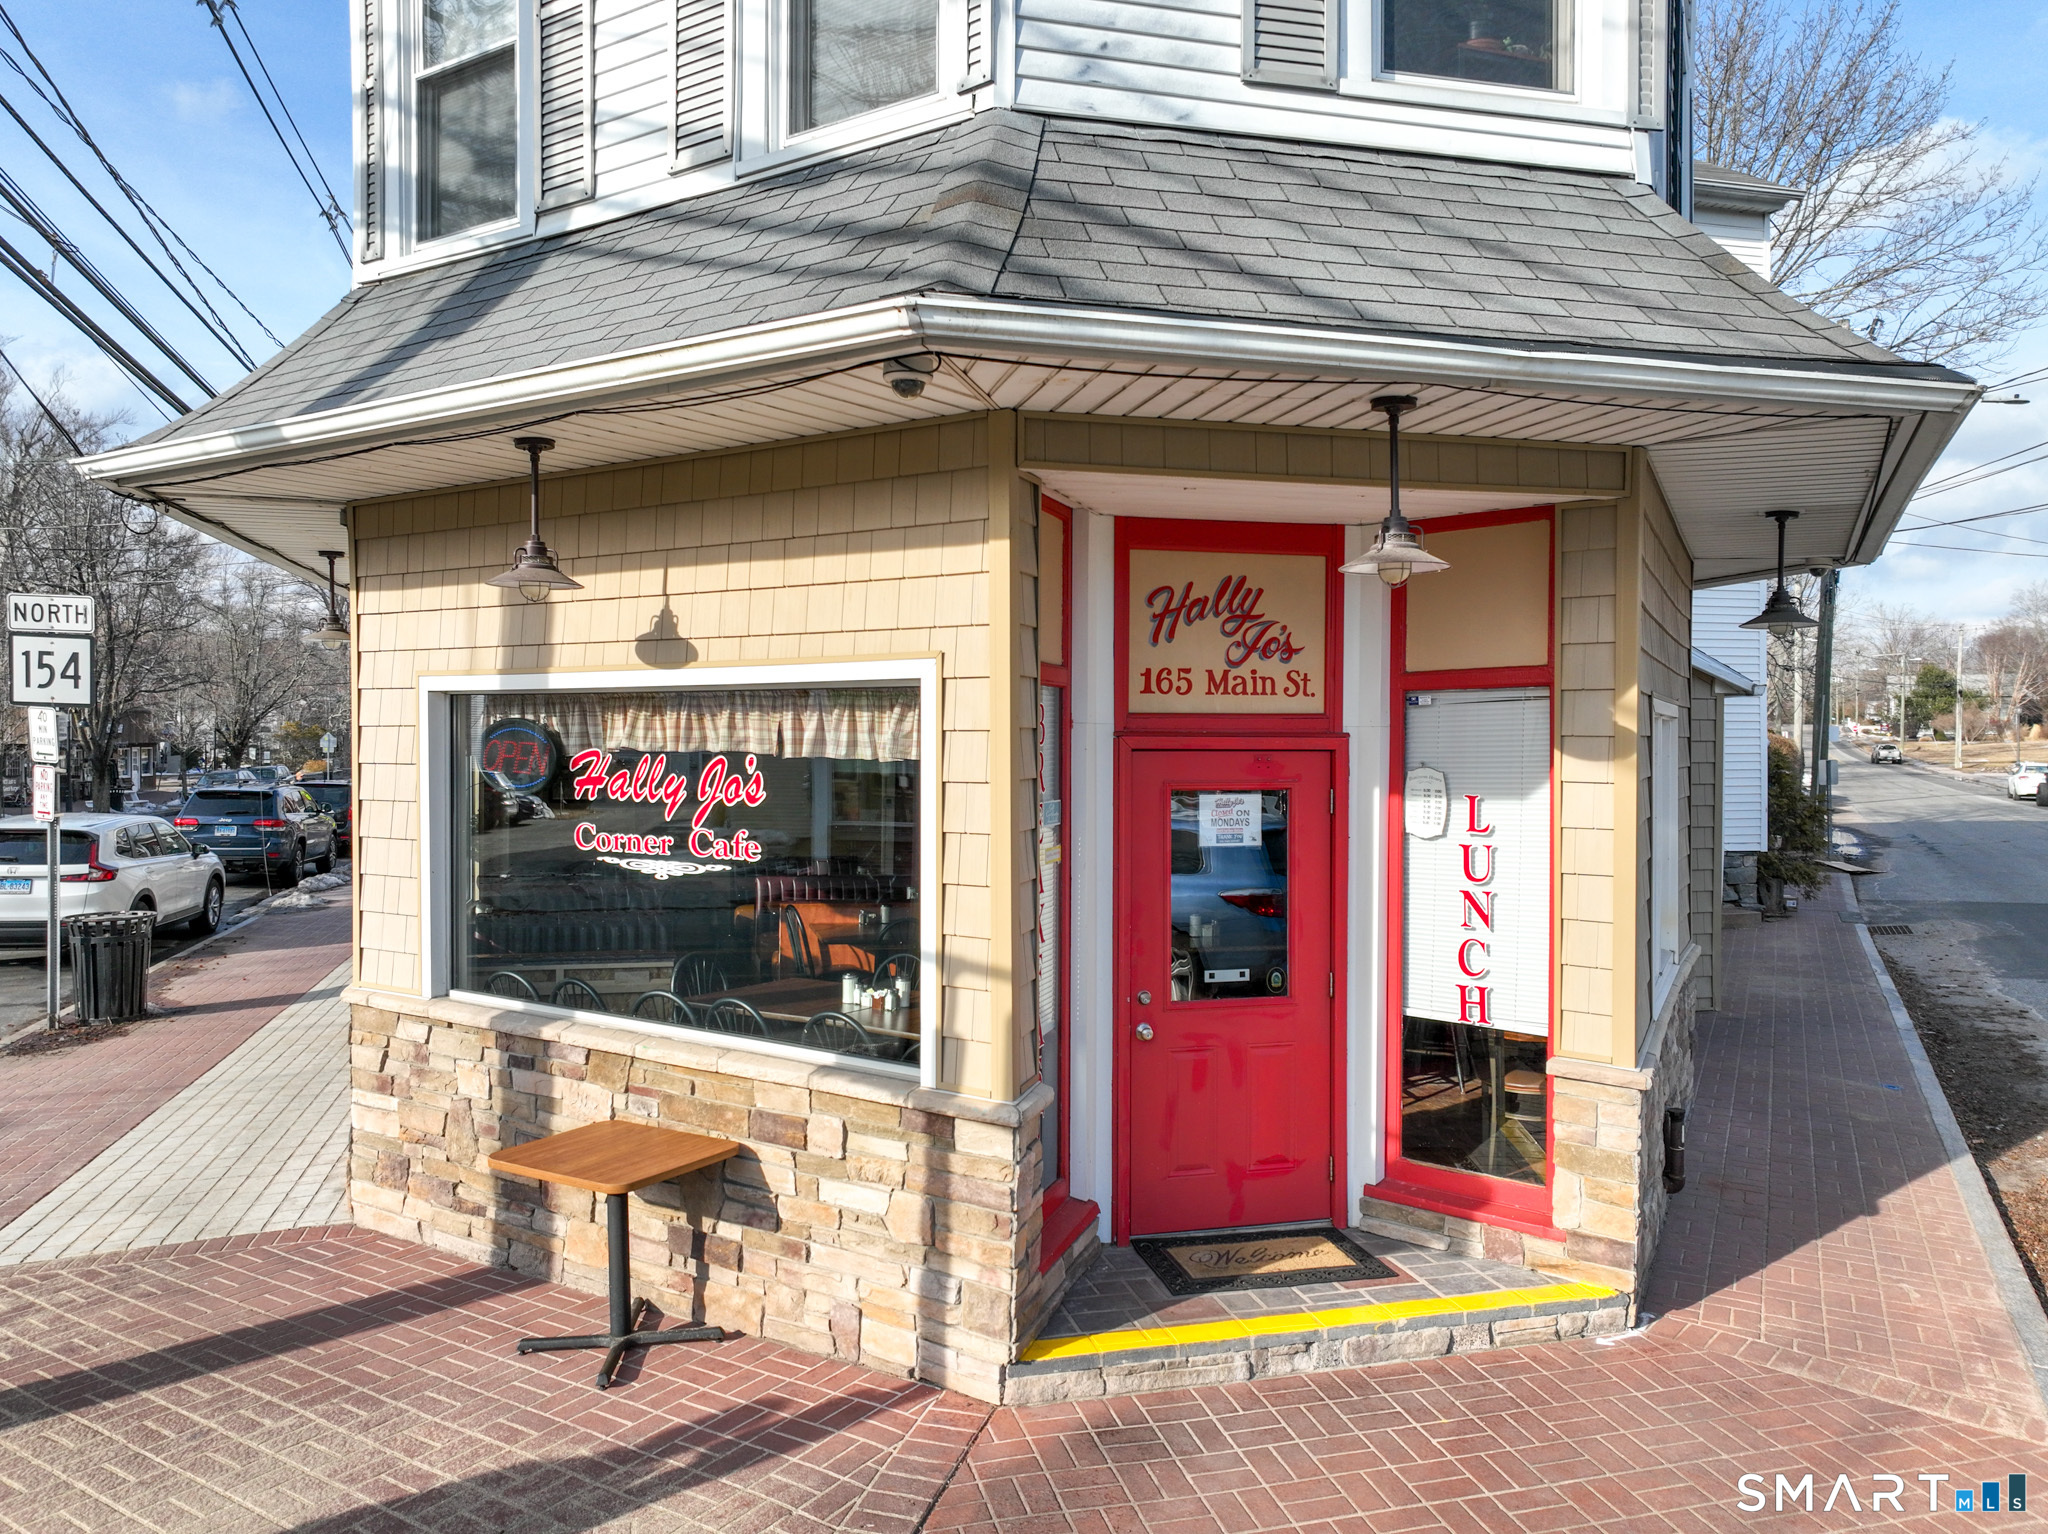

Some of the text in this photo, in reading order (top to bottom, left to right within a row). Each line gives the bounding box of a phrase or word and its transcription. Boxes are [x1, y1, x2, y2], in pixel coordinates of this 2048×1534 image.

[14, 603, 87, 624] NORTH
[1145, 575, 1265, 647] Hally
[1224, 620, 1305, 668] Jo's
[22, 650, 81, 689] 154
[1139, 667, 1315, 697] 165 Main St.
[37, 710, 47, 722] 40
[33, 737, 55, 746] PARKING
[483, 739, 551, 776] OPEN
[35, 781, 53, 792] PARKING
[40, 769, 49, 780] NO
[569, 748, 767, 828] Hally Jo's
[1210, 808, 1250, 818] Closed ON
[1210, 818, 1250, 828] MONDAYS
[573, 822, 762, 862] Corner Cafe
[1453, 793, 1495, 1026] LUNCH
